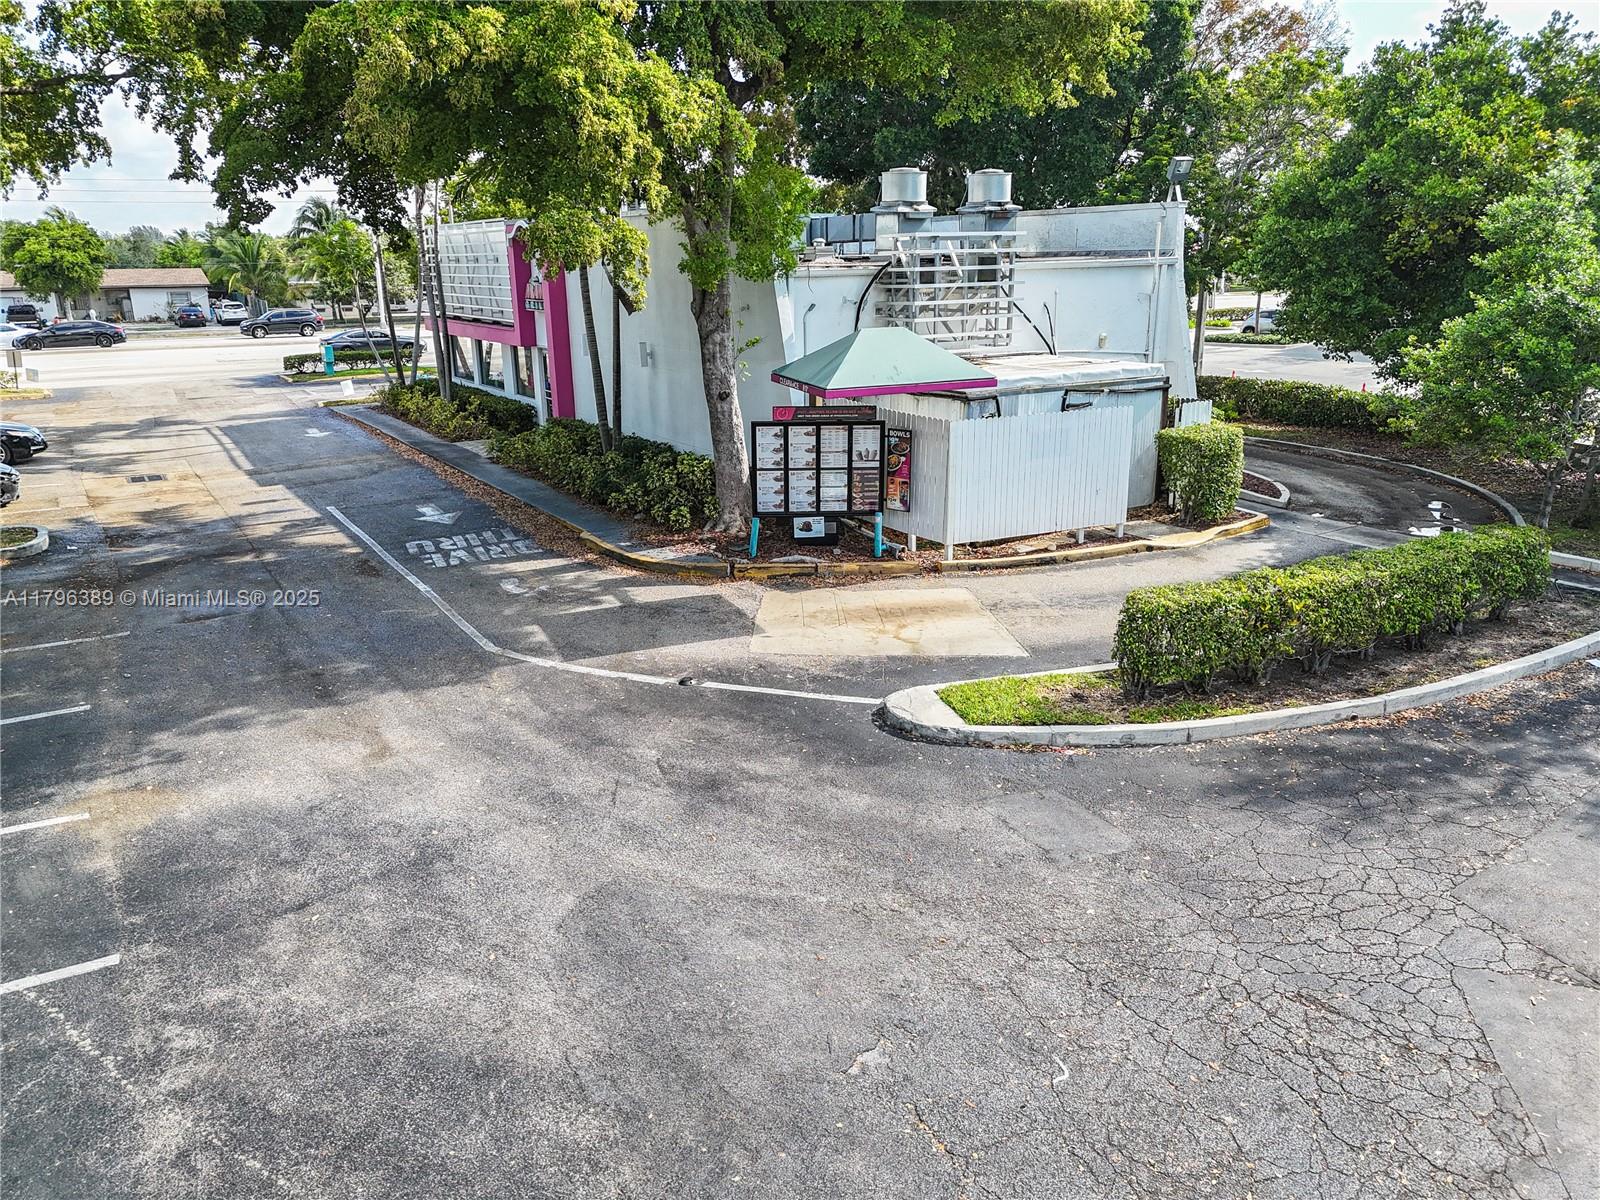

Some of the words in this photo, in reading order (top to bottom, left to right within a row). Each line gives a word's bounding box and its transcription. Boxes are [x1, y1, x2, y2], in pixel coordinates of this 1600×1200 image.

[889, 430, 911, 438] BOWLS
[405, 526, 521, 555] THRU
[419, 538, 543, 568] DRIVE
